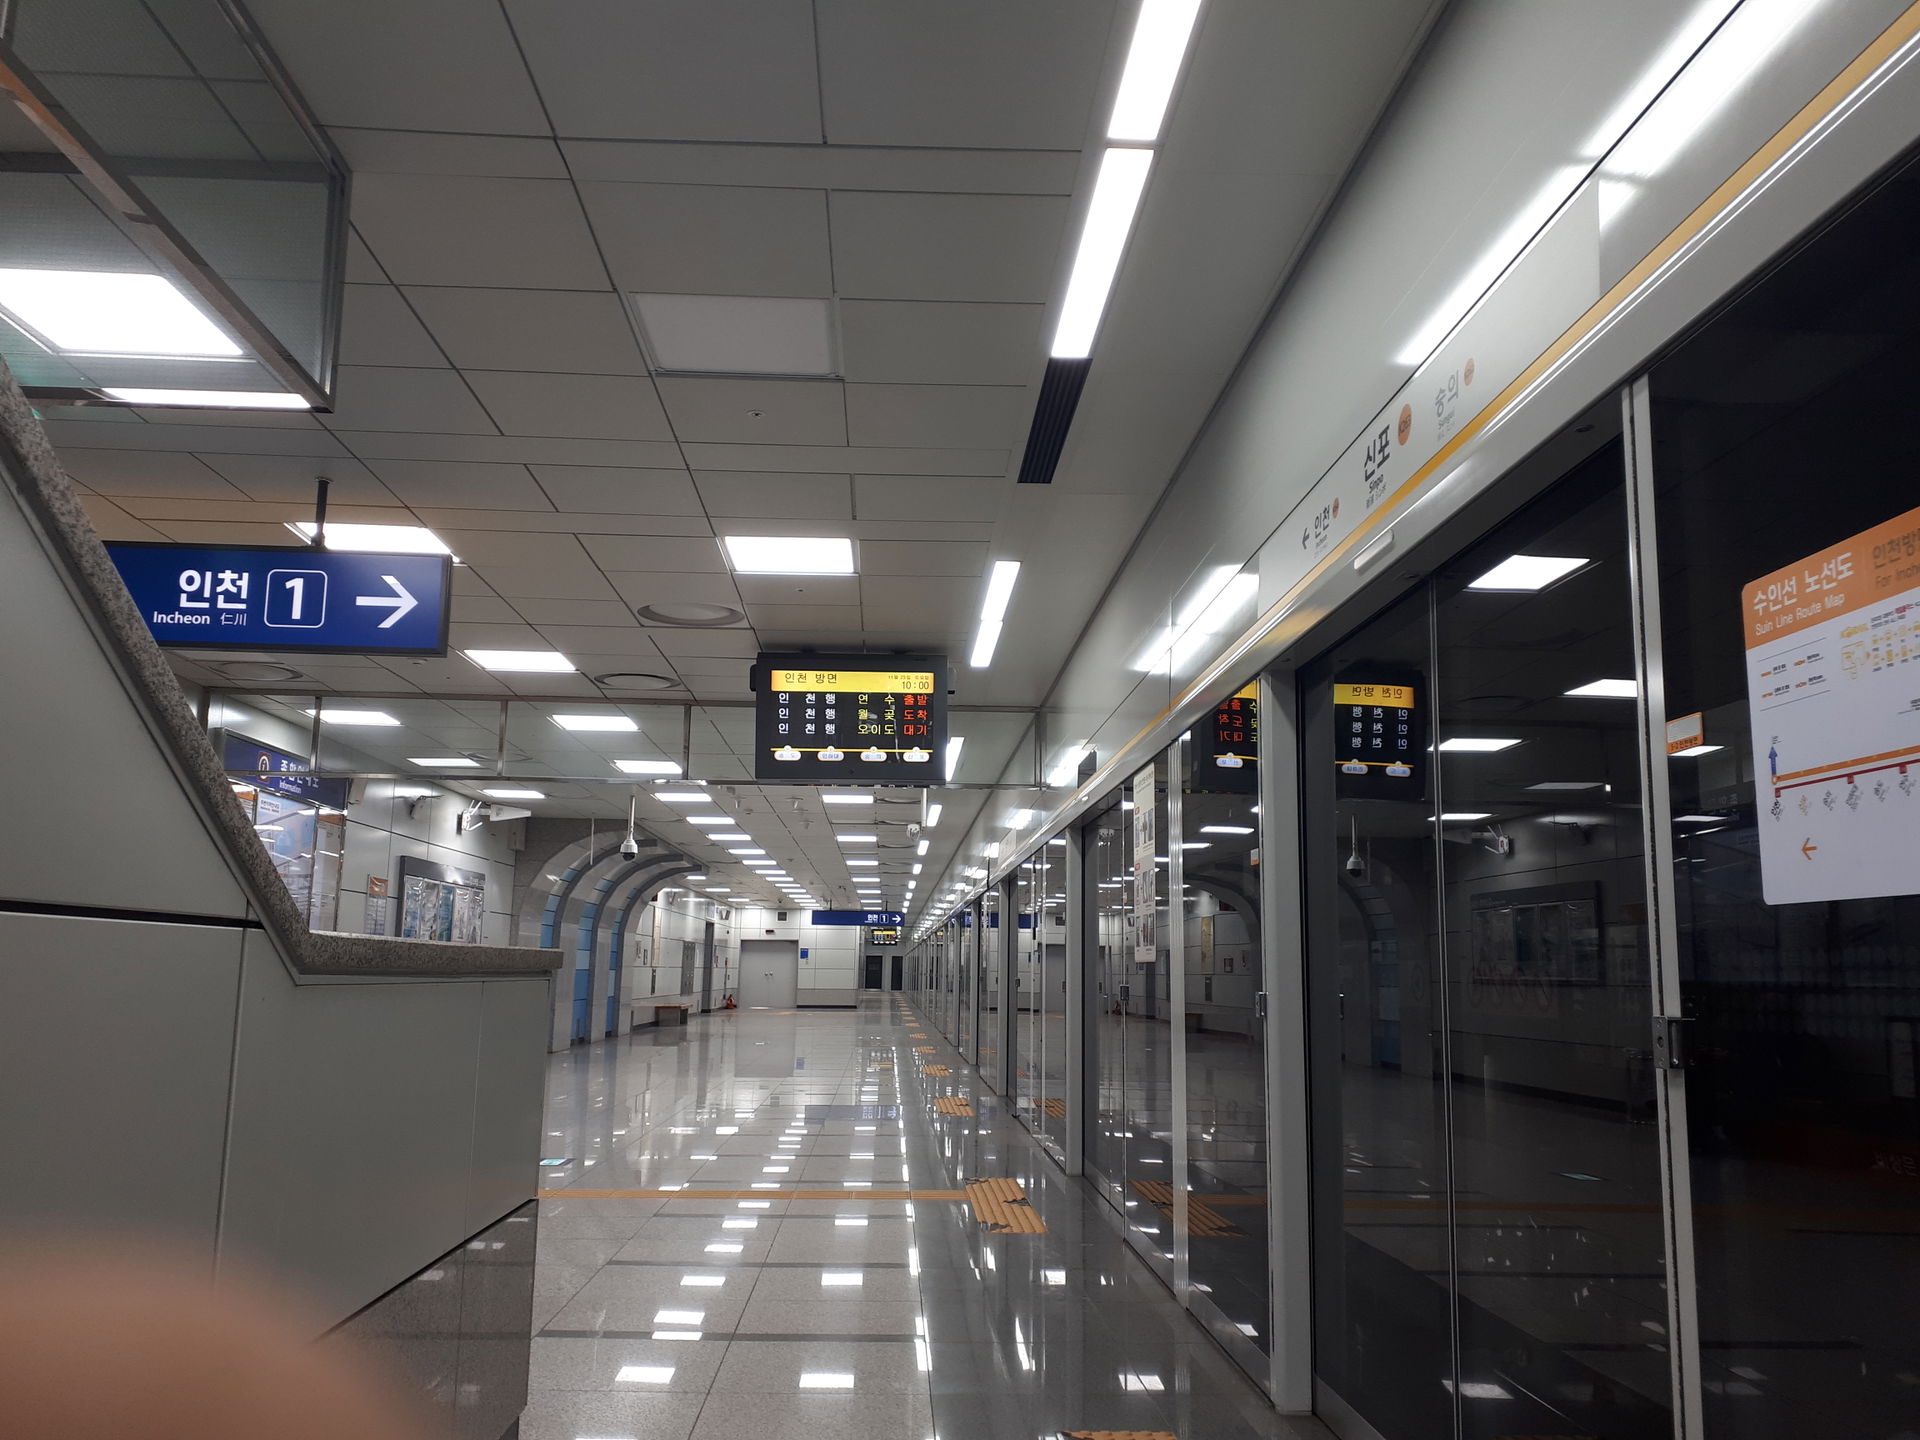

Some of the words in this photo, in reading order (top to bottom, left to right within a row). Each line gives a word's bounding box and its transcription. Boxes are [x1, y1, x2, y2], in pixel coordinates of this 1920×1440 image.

[1435, 368, 1459, 418] 숭의
[1364, 424, 1390, 482] 신포
[1315, 505, 1330, 539] 인천
[1754, 576, 1798, 616] 수인선
[1804, 552, 1854, 593] 노선도
[179, 569, 249, 609] 인천
[285, 578, 304, 620] 1
[153, 611, 211, 625] Incheon
[220, 612, 248, 626] 仁川
[1755, 621, 1774, 636] Suin
[1776, 614, 1793, 629] Line
[1796, 602, 1822, 620] Route
[1824, 593, 1845, 609] Map
[785, 672, 807, 684] 인천
[815, 673, 837, 684] 방면
[902, 681, 929, 690] 10:00
[904, 694, 927, 706] 출발
[904, 709, 927, 720] 도착
[858, 724, 895, 735] 오이도
[904, 724, 927, 735] 대기
[279, 780, 302, 793] Information
